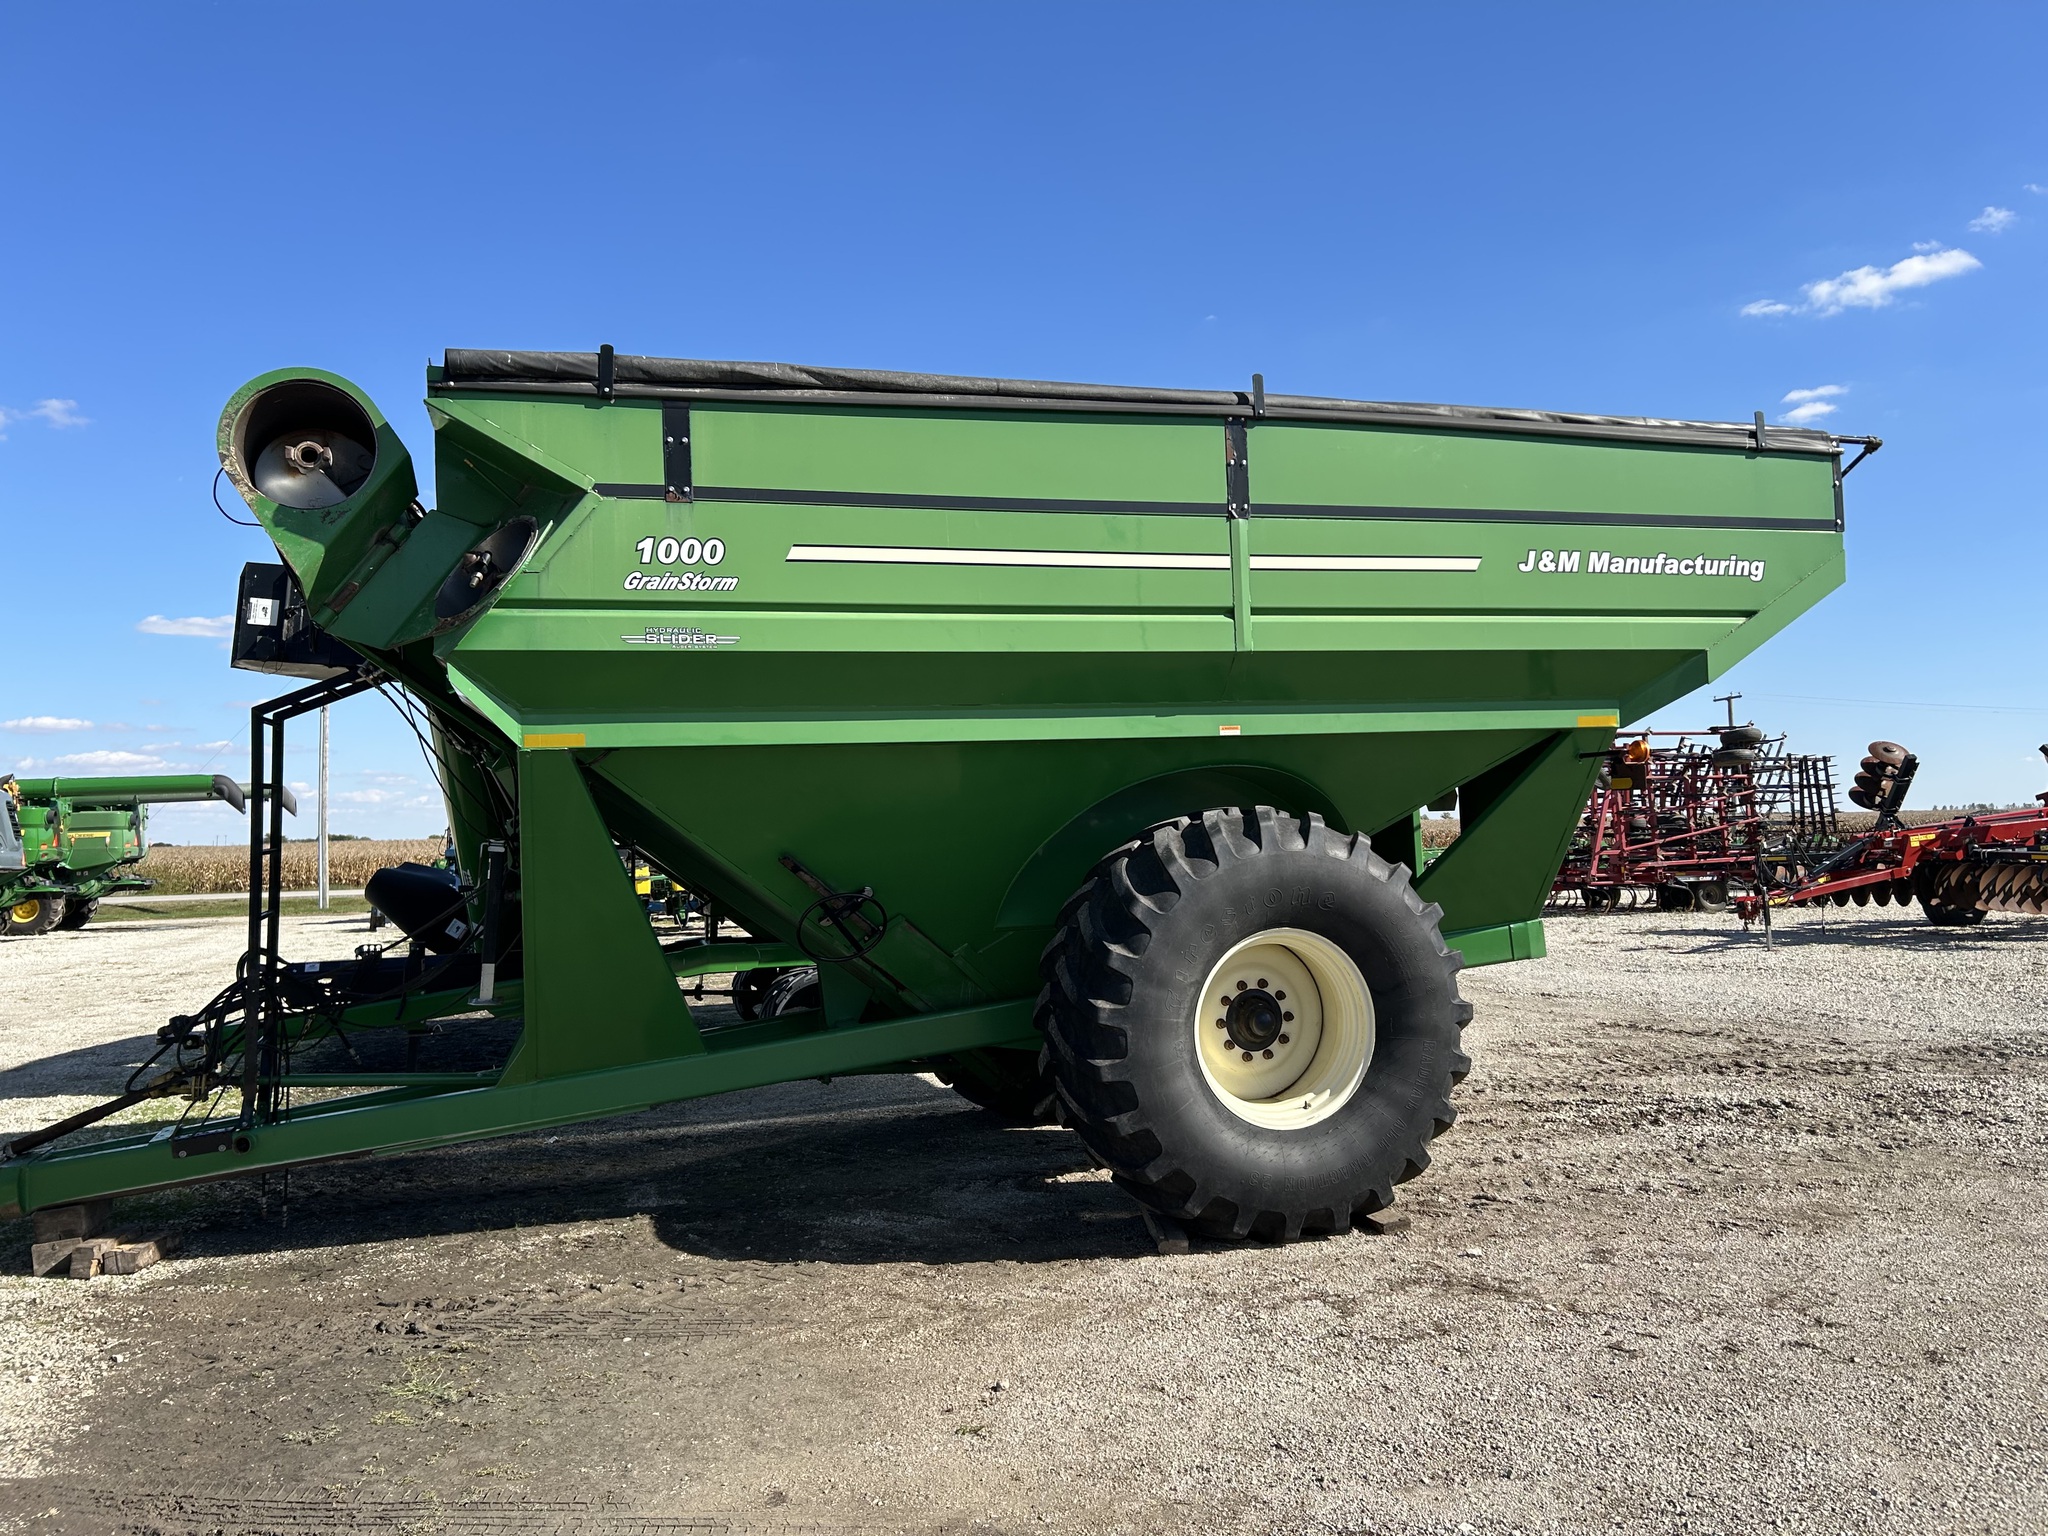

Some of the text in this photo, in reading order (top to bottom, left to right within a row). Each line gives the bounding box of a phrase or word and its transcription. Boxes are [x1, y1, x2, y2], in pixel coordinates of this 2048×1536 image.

[635, 536, 726, 566] 1000
[1517, 549, 1766, 582] J&M Manufacturing
[623, 571, 740, 591] GrainStorm
[1404, 1040, 1437, 1111] RADIAL
[1284, 1152, 1376, 1192] TRACTION
